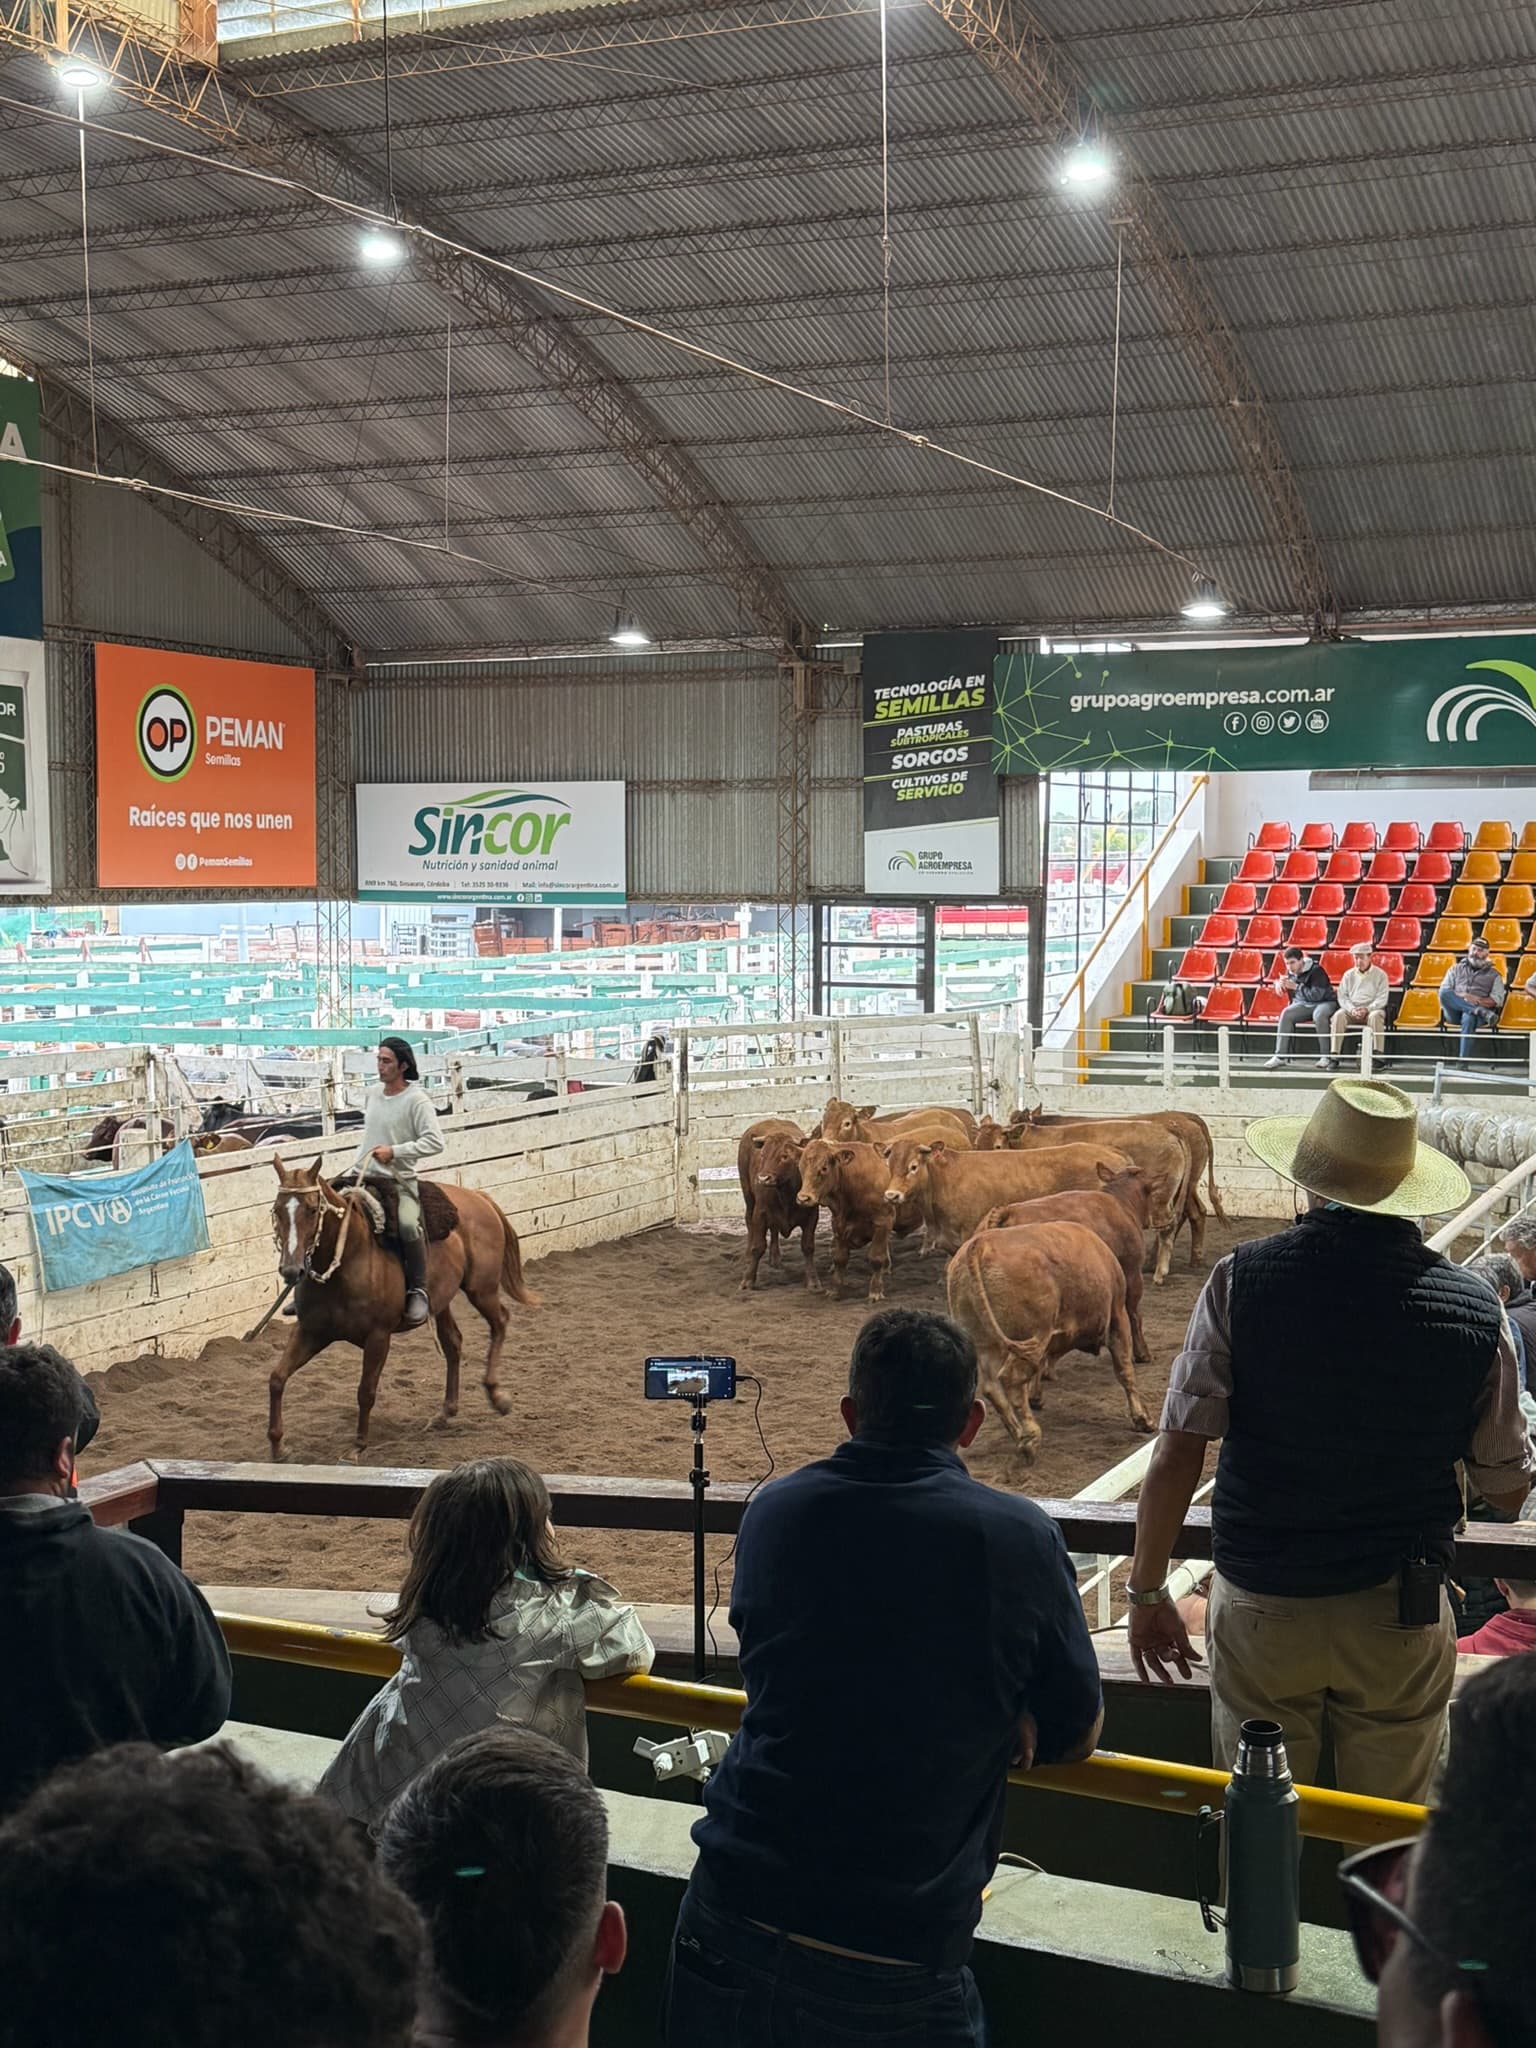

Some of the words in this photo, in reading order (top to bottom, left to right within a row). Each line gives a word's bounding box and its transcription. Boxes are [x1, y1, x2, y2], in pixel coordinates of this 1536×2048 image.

[874, 676, 962, 700] TECNOLOGÍA
[965, 675, 985, 689] EN
[874, 688, 985, 719] SEMILLAS
[1070, 688, 1335, 712] grupoagroempresa.com.ar
[147, 717, 187, 752] OP
[206, 716, 284, 750] PEMAN
[890, 729, 969, 747] SUBTROPICALES
[897, 721, 963, 738] PASTURAS
[205, 753, 241, 766] Semillas
[891, 746, 968, 770] SORGOS
[891, 773, 948, 789] CULTIVOS
[951, 771, 968, 782] DE
[896, 782, 964, 801] SERVICIO
[129, 804, 186, 827] Raíces
[190, 811, 220, 834] que
[225, 813, 252, 828] nos
[256, 814, 292, 829] unen
[408, 806, 572, 856] Sincor
[422, 859, 468, 871] Nutrición
[471, 862, 477, 872] y
[479, 860, 520, 871] sanidad
[522, 860, 558, 871] animal
[918, 851, 943, 860] GRUPO
[918, 861, 973, 870] AGROEMPRESA
